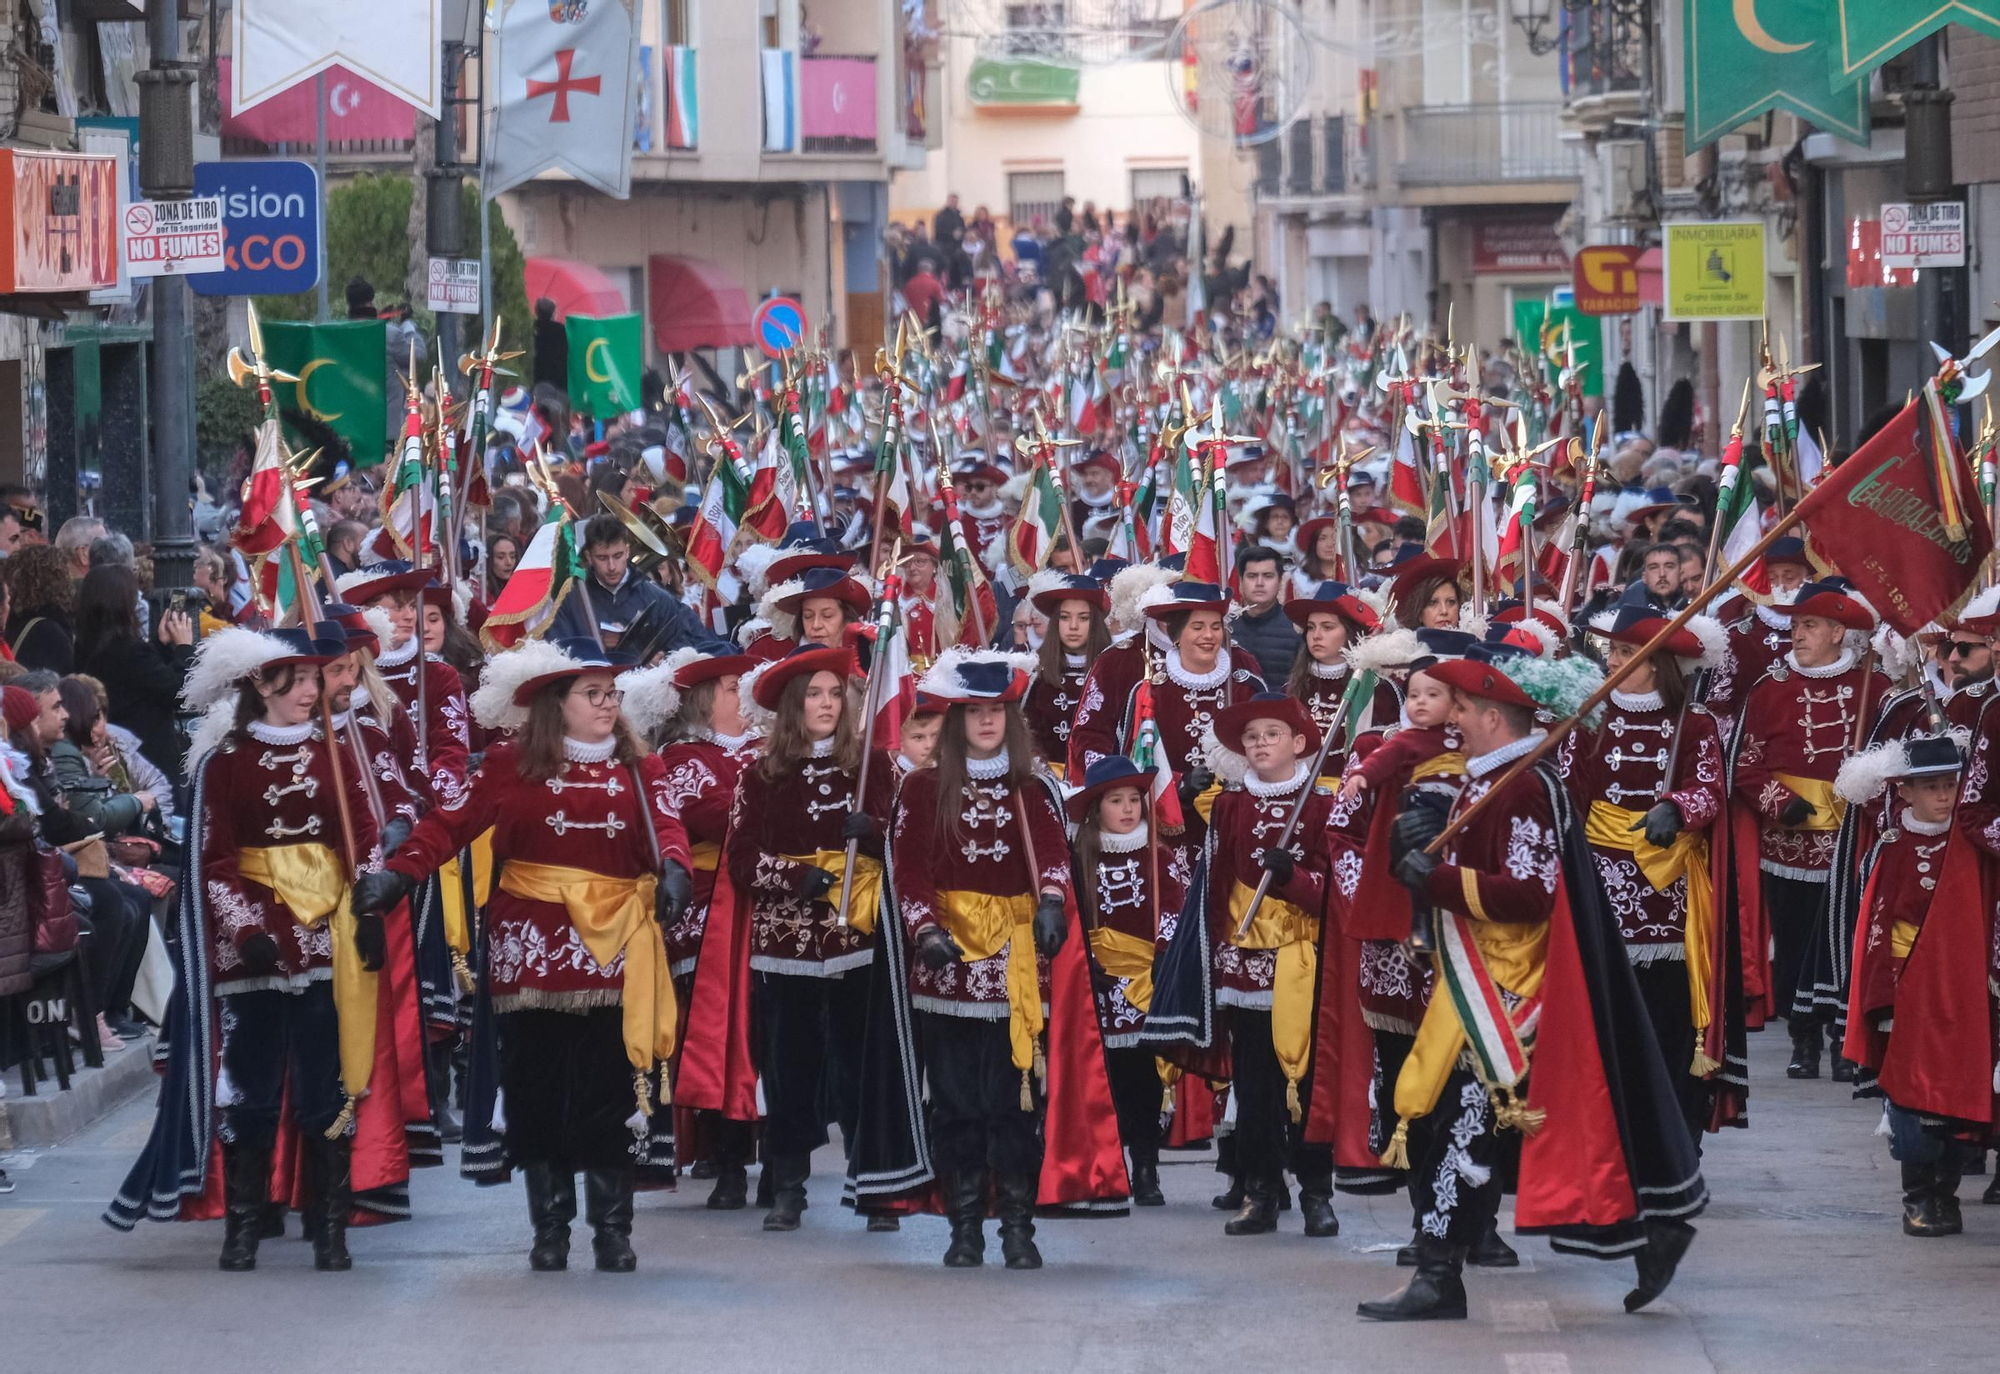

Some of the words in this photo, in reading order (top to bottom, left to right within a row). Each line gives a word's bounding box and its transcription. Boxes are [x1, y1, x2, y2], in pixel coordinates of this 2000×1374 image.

[154, 203, 180, 222] ZONA
[181, 202, 194, 220] DE
[195, 200, 218, 219] TIRO
[198, 185, 305, 219] ision
[1907, 205, 1928, 221] ZONA
[1930, 205, 1940, 221] DE
[1941, 204, 1960, 221] TIRO
[156, 225, 170, 234] por
[171, 224, 179, 233] tu
[180, 222, 218, 233] seguridad
[1672, 227, 1758, 241] INMOBILIARIA
[130, 239, 155, 260] NO
[159, 234, 220, 259] FUMES
[1885, 235, 1907, 254] NO
[1910, 234, 1960, 254] FUMES
[459, 262, 466, 276] DE
[467, 263, 478, 277] TIRO
[431, 284, 445, 300] NO
[446, 285, 477, 303] FUMES
[1583, 297, 1639, 311] TABACOS
